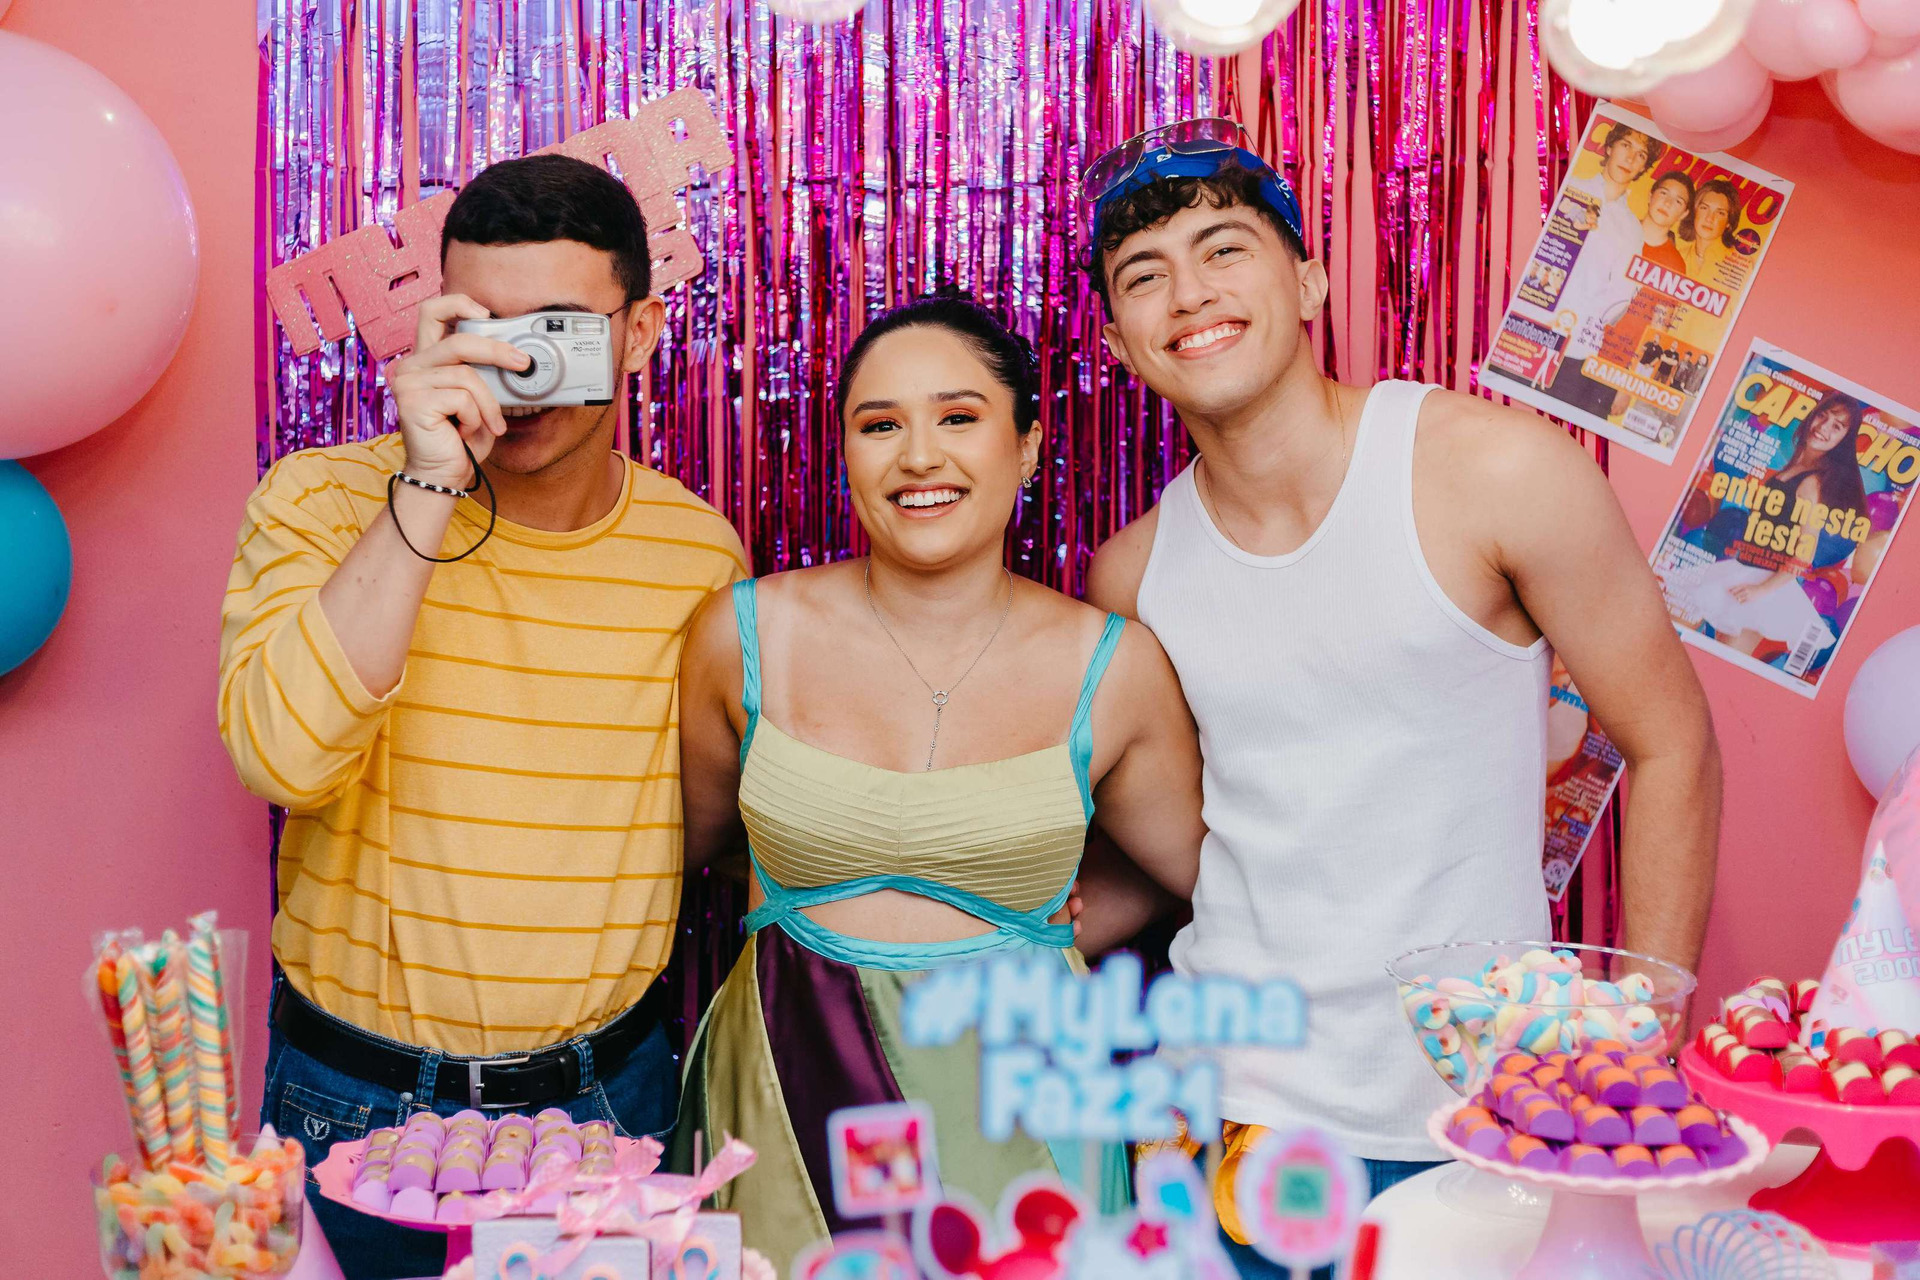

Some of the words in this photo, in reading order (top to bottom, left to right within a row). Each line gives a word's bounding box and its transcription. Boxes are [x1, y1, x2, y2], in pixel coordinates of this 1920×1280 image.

[1628, 258, 1728, 316] HANSON
[1586, 358, 1680, 410] RAIMUNDOS
[1772, 370, 1806, 392] CONVERSA
[1710, 472, 1786, 516] entre
[1790, 497, 1872, 543] nesta
[1743, 511, 1816, 563] festa
